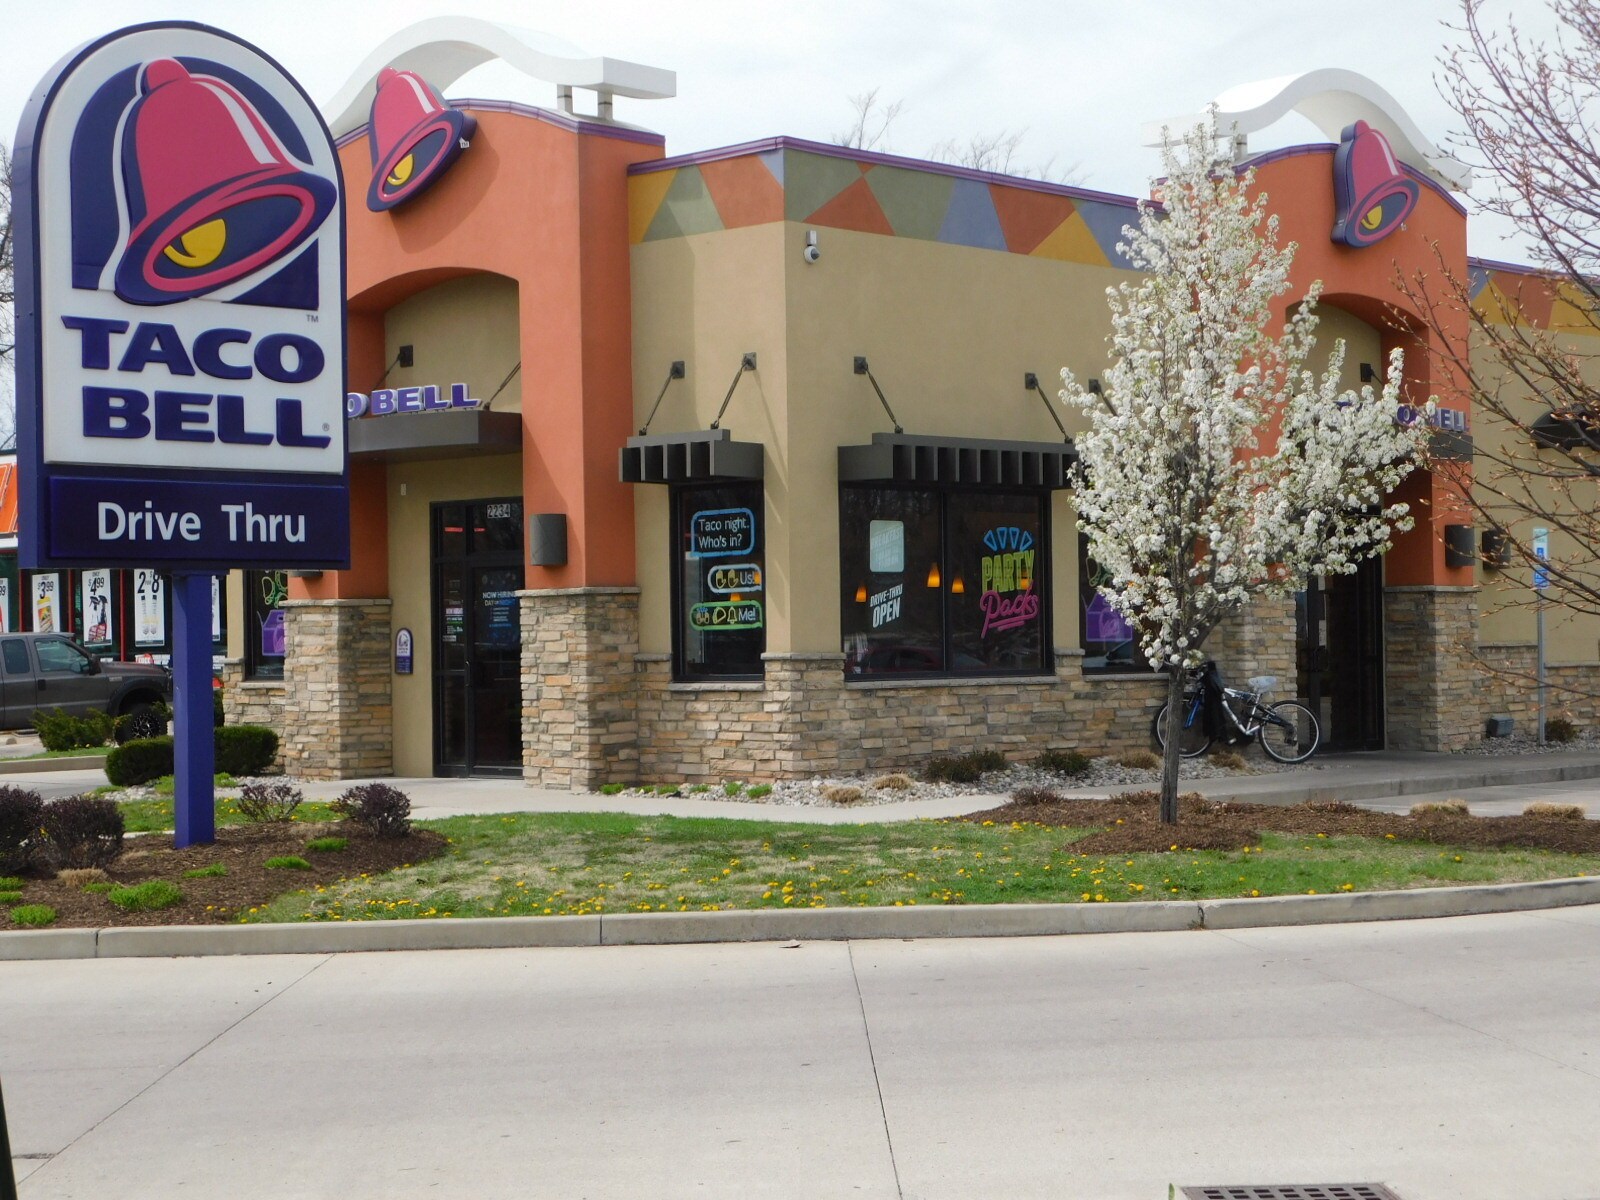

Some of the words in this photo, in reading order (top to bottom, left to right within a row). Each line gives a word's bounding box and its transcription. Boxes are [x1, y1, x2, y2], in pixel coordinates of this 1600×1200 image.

[61, 315, 325, 383] TACO
[372, 383, 482, 415] BELL
[83, 385, 331, 449] BELL
[97, 500, 201, 541] Drive
[221, 501, 306, 544] Thru
[487, 504, 510, 518] 2234
[698, 518, 722, 532] Taco
[698, 535, 727, 550] Who's
[729, 533, 743, 547] in?
[137, 571, 146, 594] 2
[739, 570, 755, 585] Us!
[981, 549, 1035, 593] PARTY
[870, 583, 903, 608] DRIVE-THRU
[980, 579, 1039, 638] Packs
[872, 596, 901, 629] OPEN
